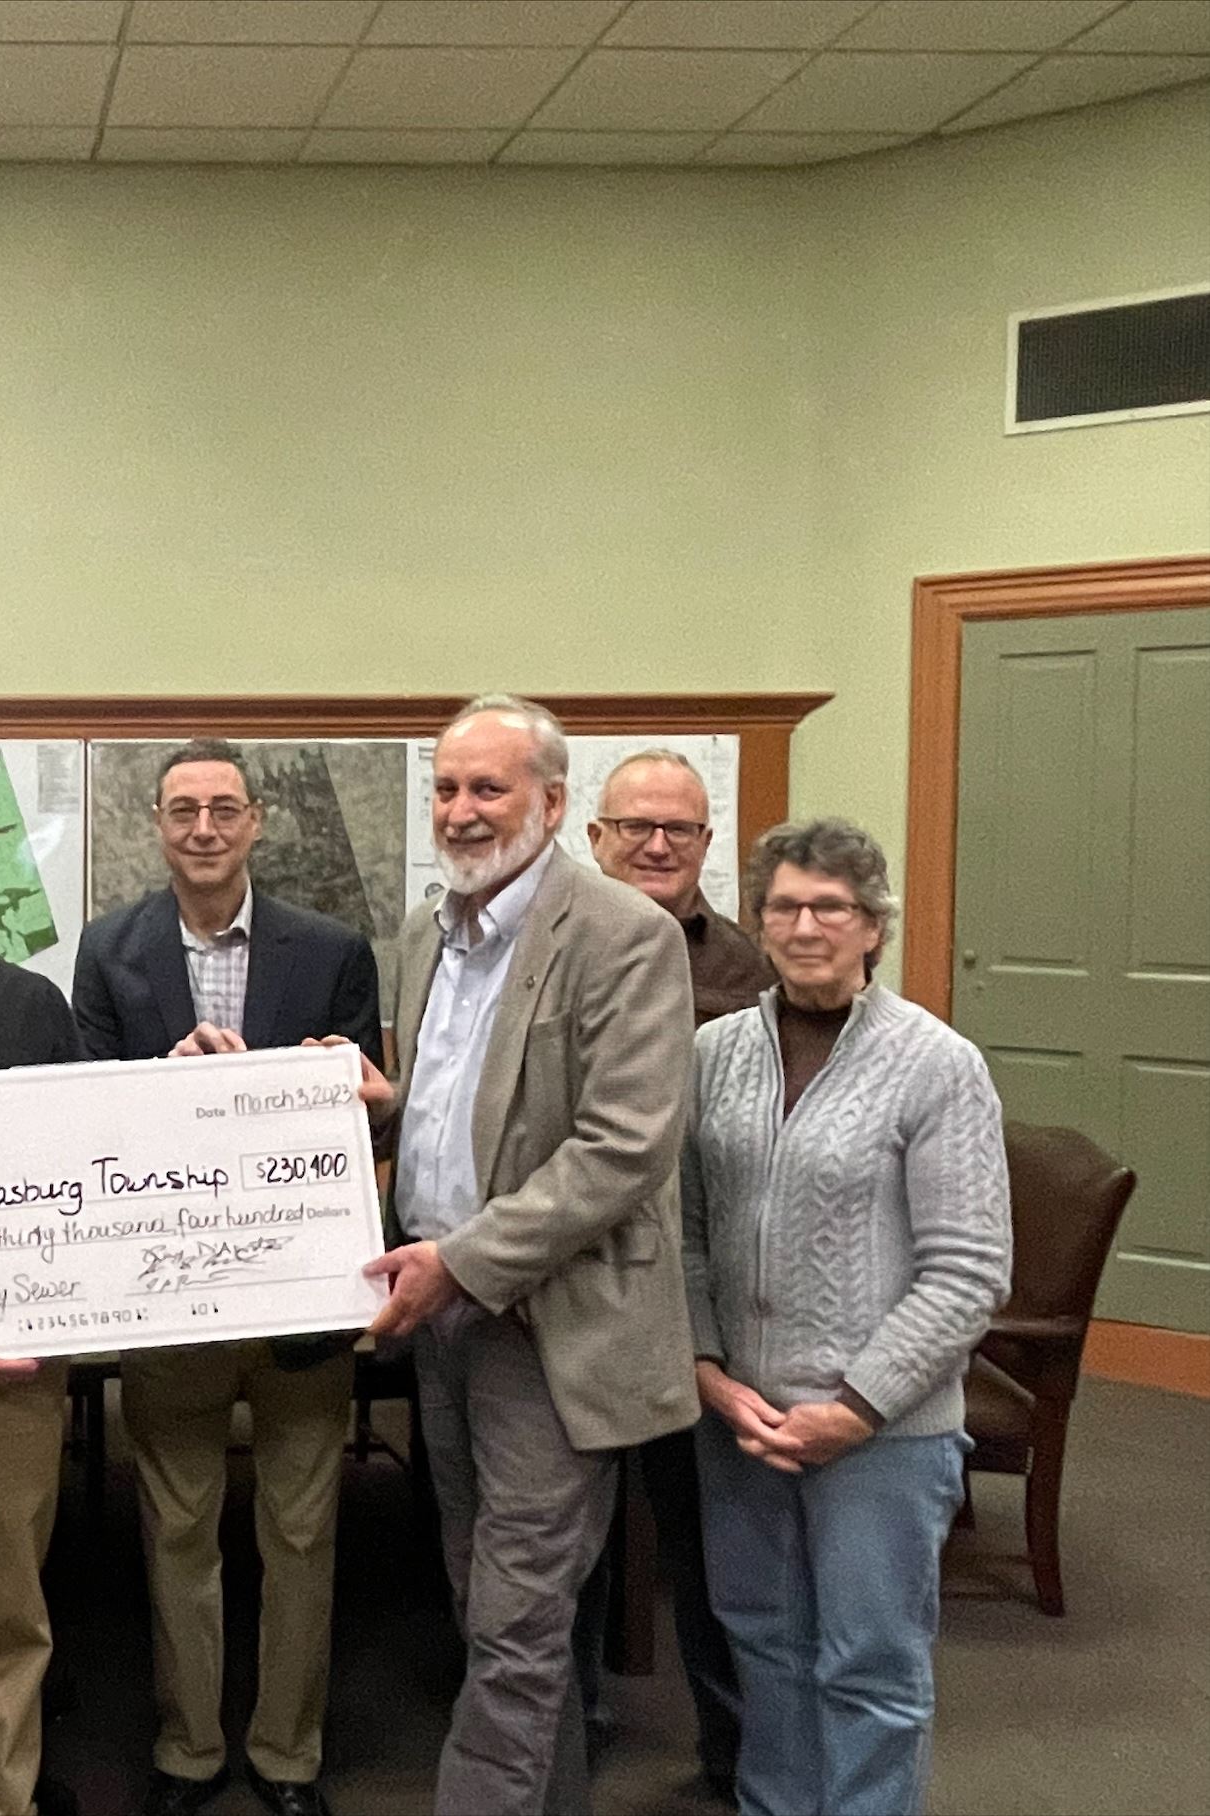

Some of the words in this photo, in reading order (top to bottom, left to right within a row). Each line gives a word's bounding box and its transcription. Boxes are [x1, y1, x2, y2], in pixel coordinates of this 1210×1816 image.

[195, 1107, 226, 1119] Date
[234, 1089, 295, 1116] March
[92, 1156, 229, 1198] Township
[177, 1207, 221, 1238] four
[225, 1202, 304, 1229] hundred
[306, 1207, 351, 1220] Dollars
[13, 1273, 81, 1303] Sewer
